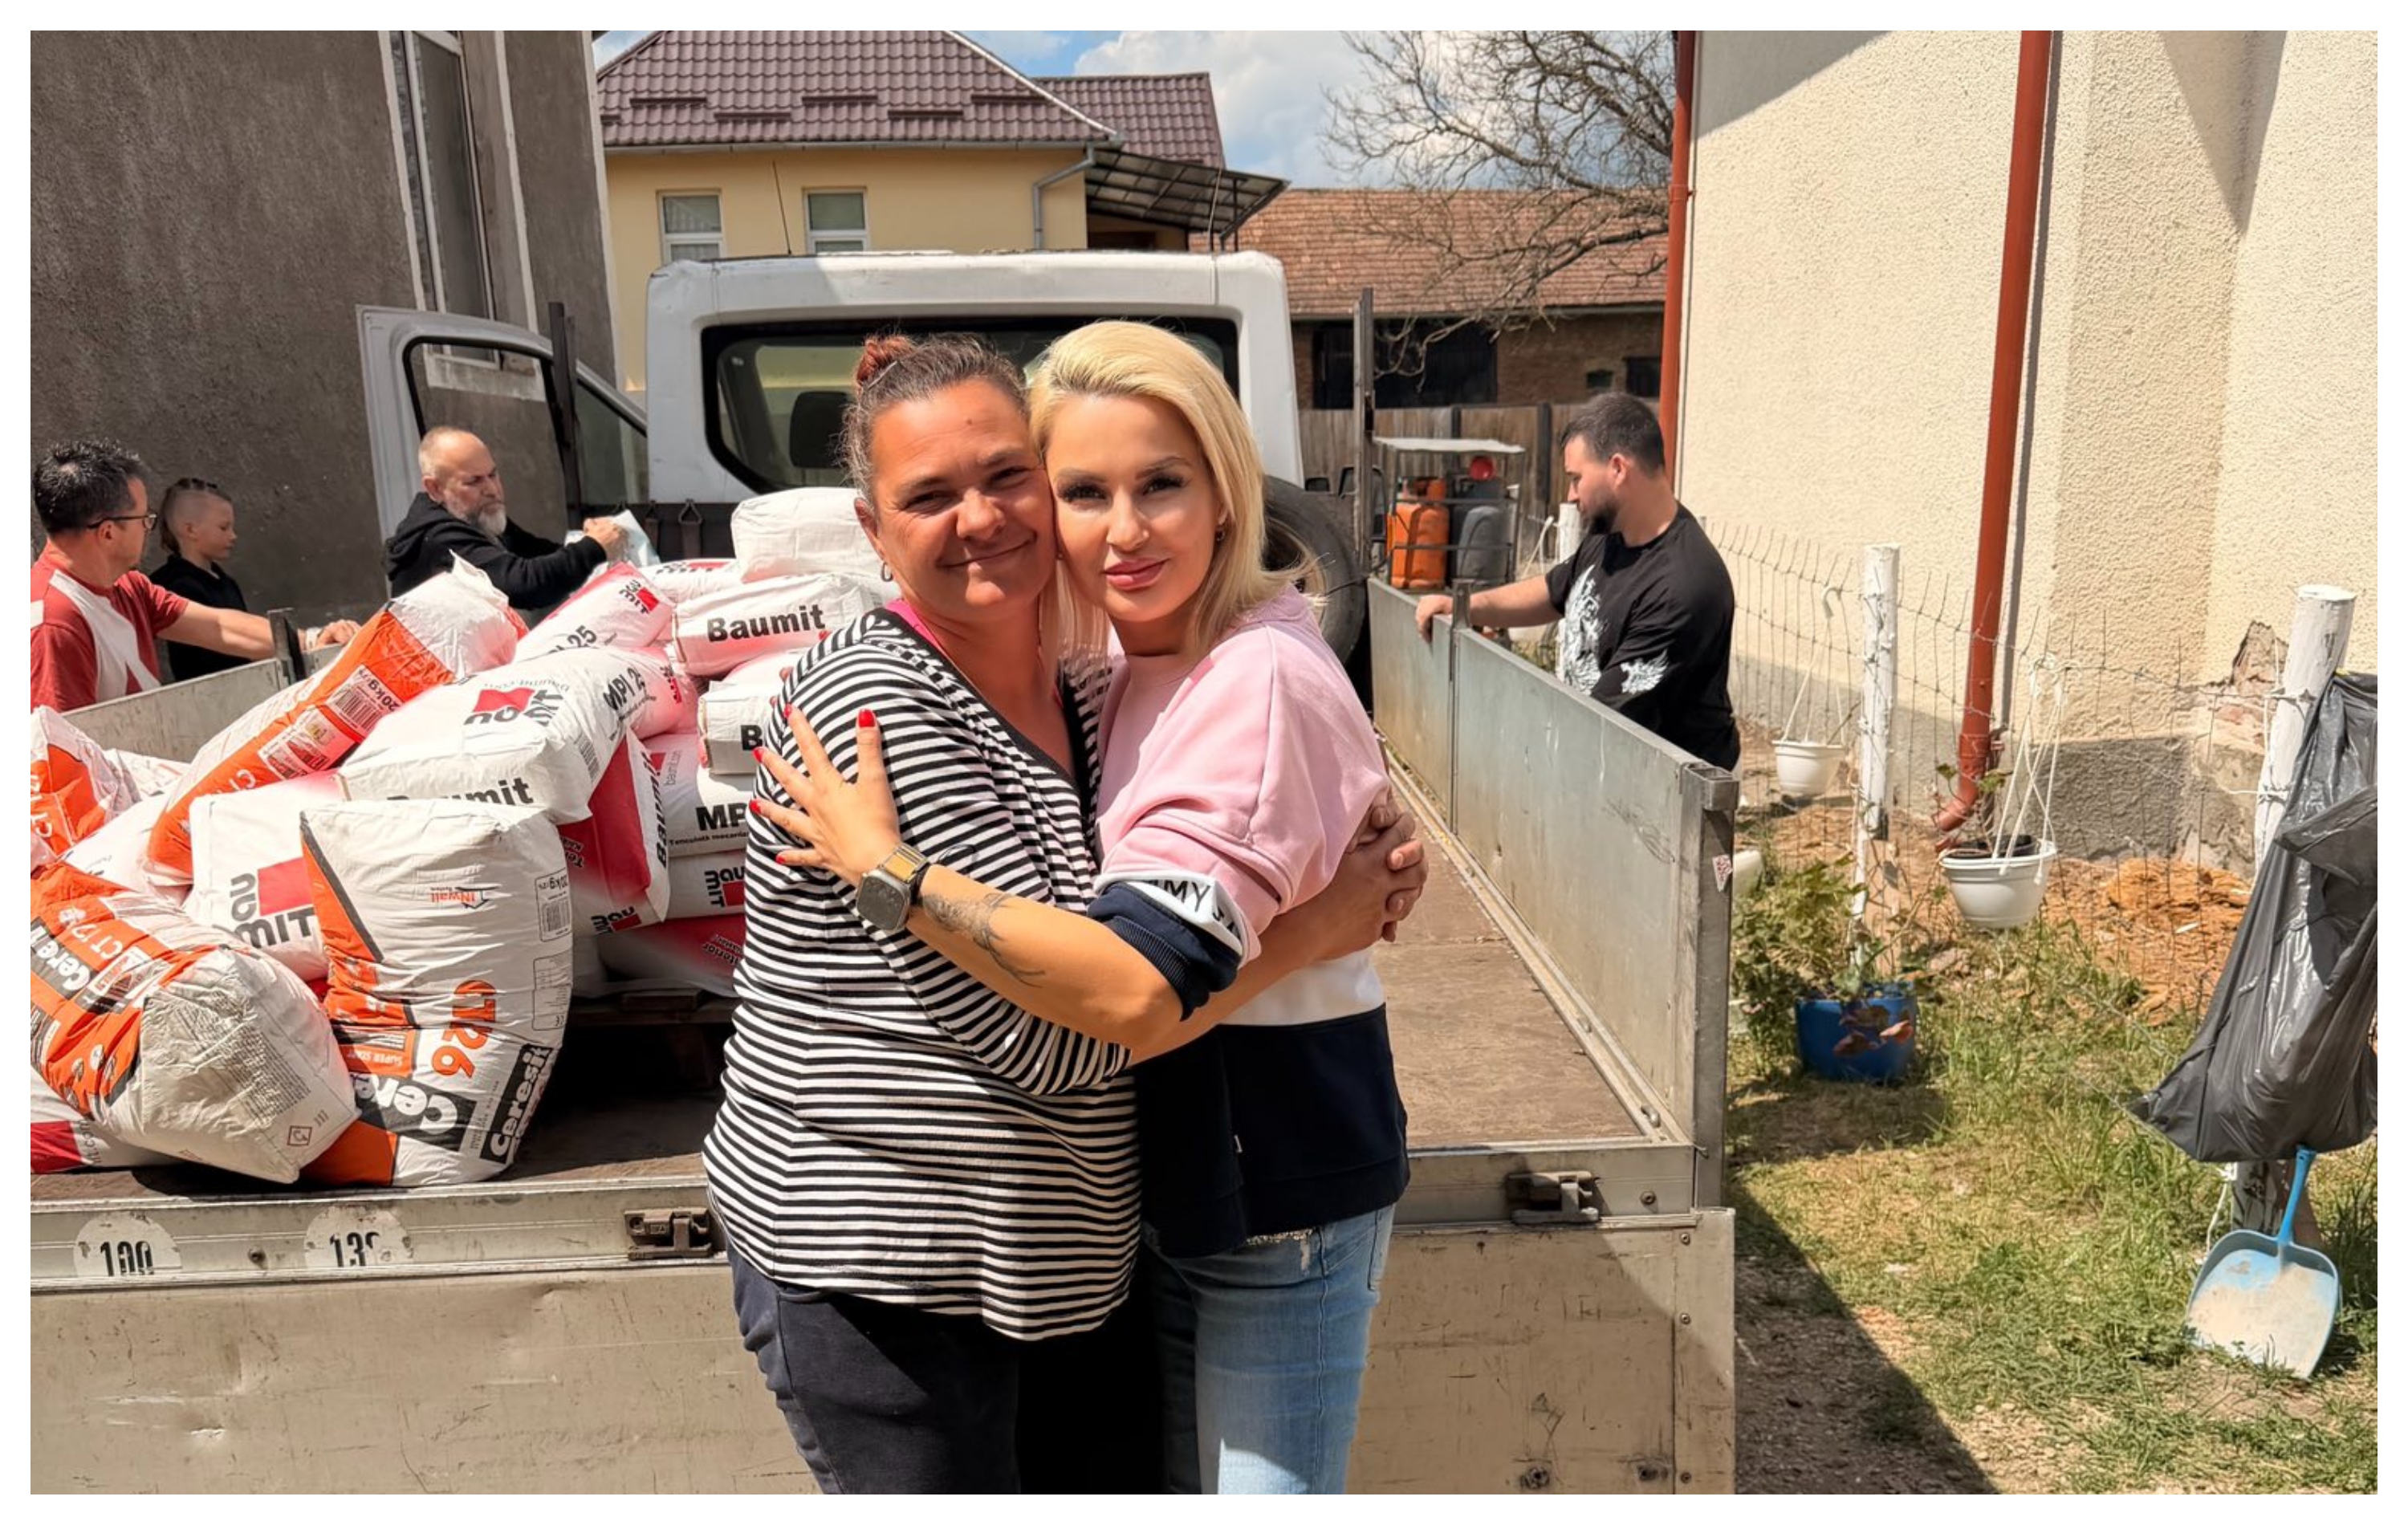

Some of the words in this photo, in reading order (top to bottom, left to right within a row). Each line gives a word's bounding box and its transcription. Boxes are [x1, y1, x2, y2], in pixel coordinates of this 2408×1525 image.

[567, 624, 598, 648] 25
[707, 604, 826, 643] Baumit
[603, 670, 637, 711] MPI
[352, 1072, 458, 1136] Cere
[490, 1045, 554, 1157] Ceresit
